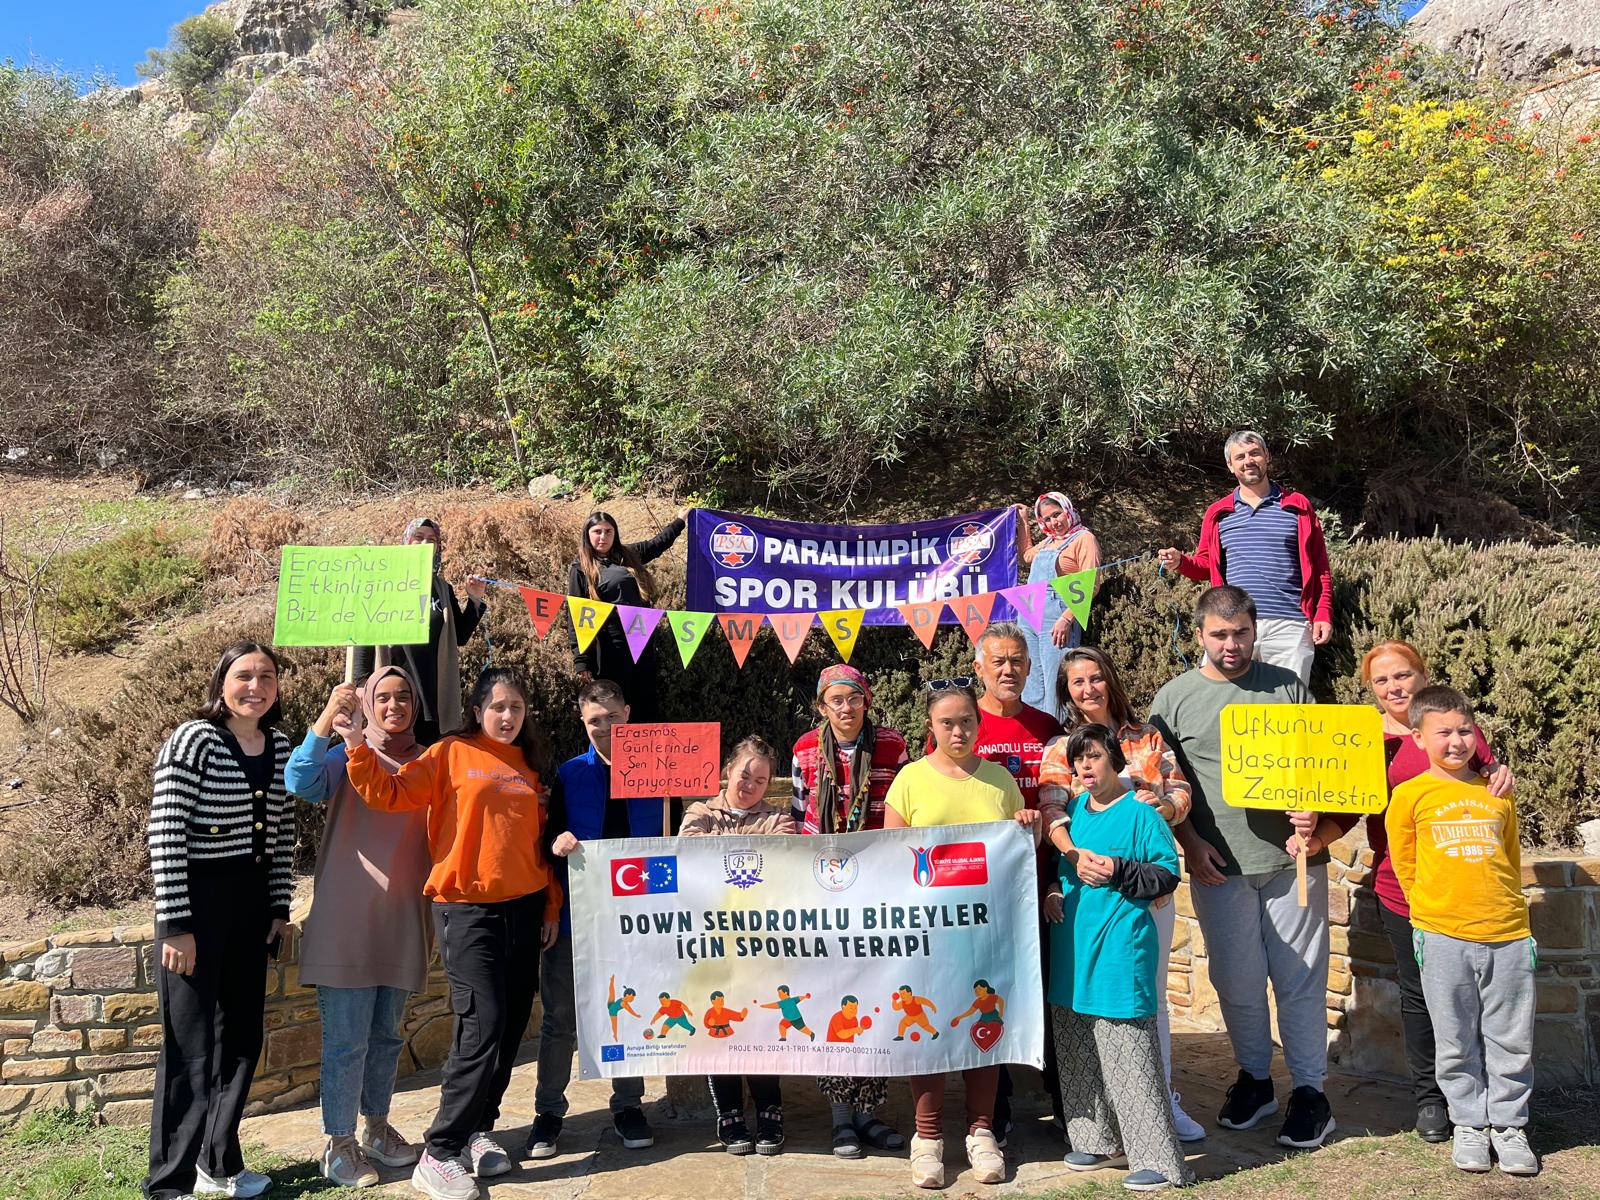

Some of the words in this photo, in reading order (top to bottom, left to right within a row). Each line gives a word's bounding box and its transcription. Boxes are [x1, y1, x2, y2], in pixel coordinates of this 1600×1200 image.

[716, 535, 751, 551] PSK
[763, 531, 942, 566] PARALİMPİK
[290, 553, 388, 572] Erasmus
[714, 576, 818, 609] SPOR
[831, 566, 989, 609] KULÜBÜ
[287, 599, 317, 622] Biz
[331, 597, 355, 623] de
[536, 596, 852, 645] ERASMUS
[913, 580, 1085, 627] DAYS
[622, 737, 700, 754] Günlerinde
[977, 742, 1021, 755] ANADOLU
[1023, 742, 1044, 753] EFES
[628, 756, 647, 769] Sen
[655, 756, 677, 770] Ne
[733, 855, 745, 869] B
[619, 911, 693, 935] DOWN
[703, 908, 849, 931] SENDROMLU
[862, 902, 989, 930] BİREYLER
[676, 932, 725, 964] İÇİN
[735, 936, 829, 957] SPORLA
[838, 930, 931, 958] TERAPİ
